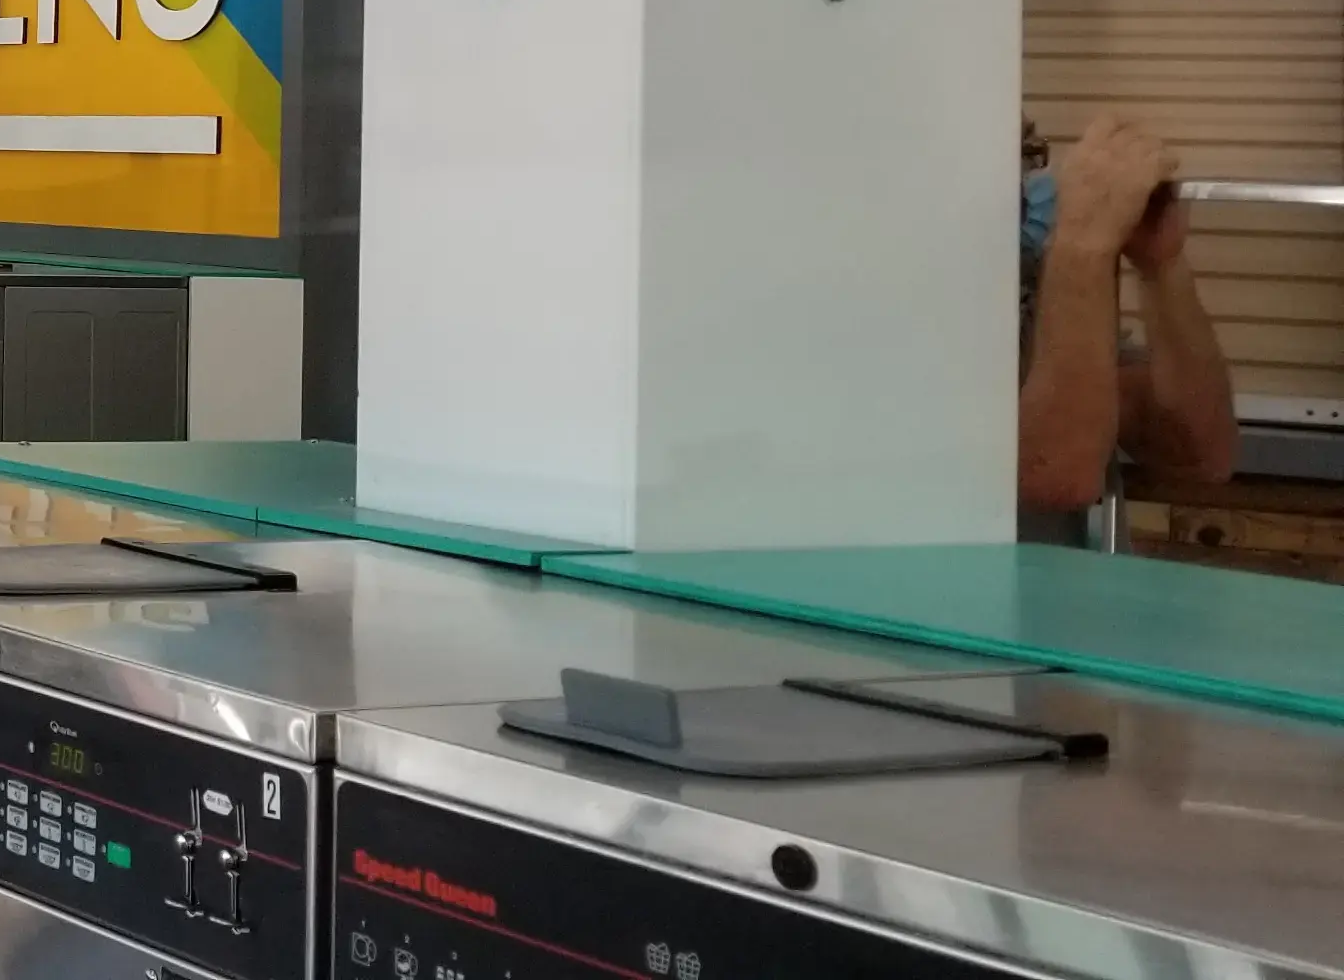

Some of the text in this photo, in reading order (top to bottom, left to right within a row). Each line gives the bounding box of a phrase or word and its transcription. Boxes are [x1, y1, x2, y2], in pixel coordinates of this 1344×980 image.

[266, 779, 277, 815] 2
[354, 849, 496, 917] Speed Queen
